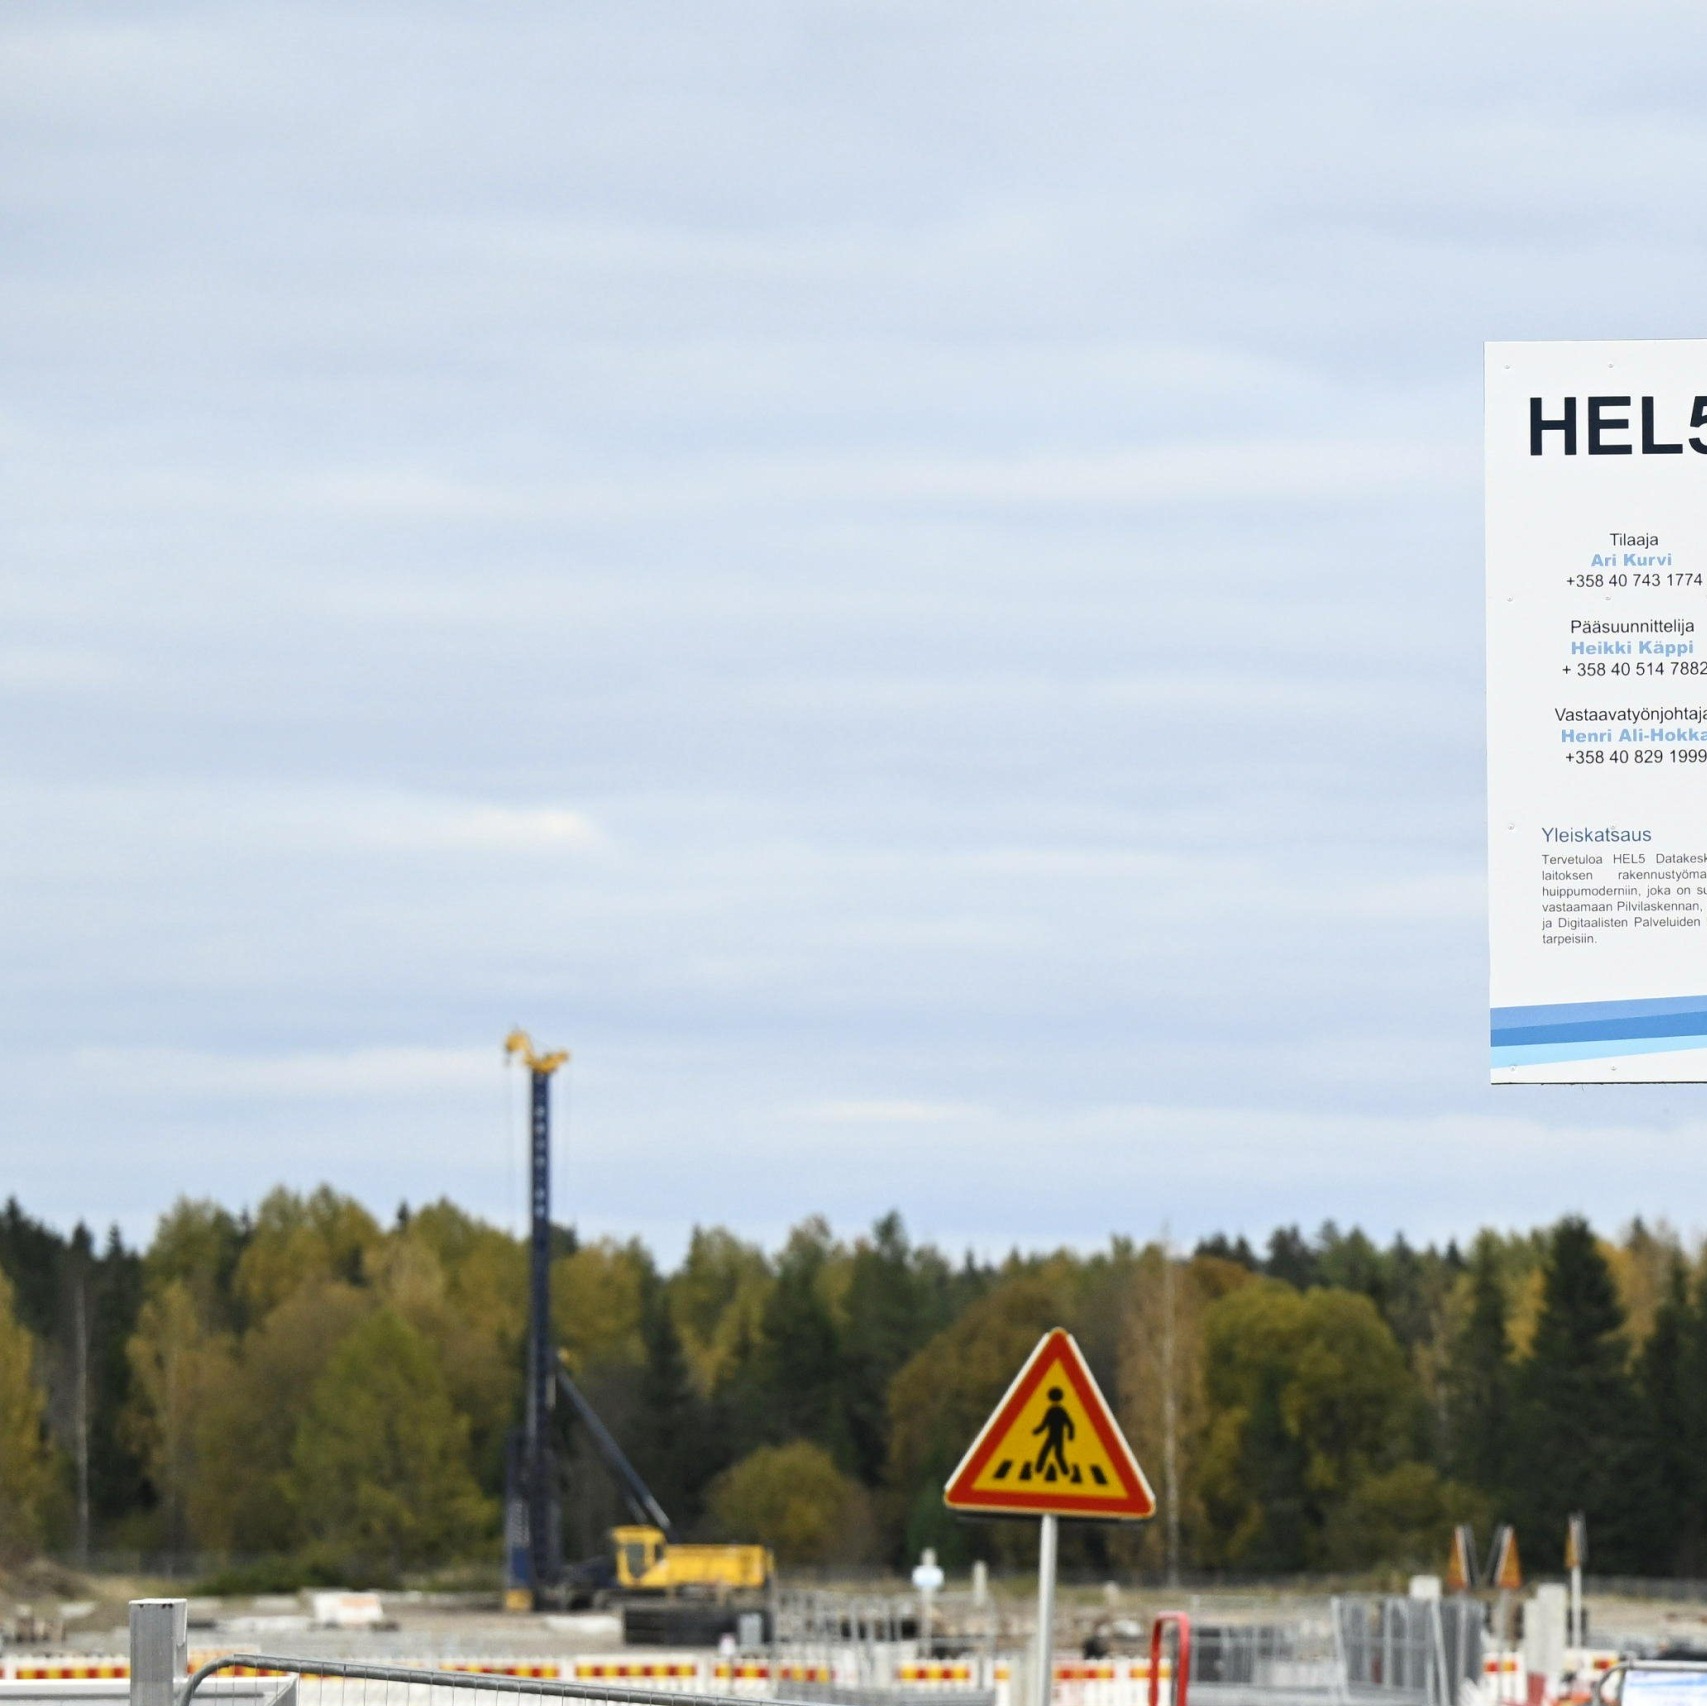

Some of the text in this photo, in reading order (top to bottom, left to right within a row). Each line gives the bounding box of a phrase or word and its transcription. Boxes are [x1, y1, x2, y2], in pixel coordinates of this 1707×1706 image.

[1610, 533, 1658, 549] Tilaaja
[1591, 553, 1671, 566] Ari Kurvi
[1567, 573, 1702, 587] +358 40 743 1774
[1571, 619, 1694, 636] Pääsuunnittelija
[1572, 640, 1693, 657] Heikki Käppi
[1578, 663, 1605, 676] 358
[1611, 662, 1630, 676] 40
[1636, 662, 1664, 676] 514
[1671, 661, 1707, 675] 7882
[1562, 729, 1611, 743] Henri
[1566, 749, 1707, 764] +358 40 829 1999
[1542, 828, 1651, 842] Yleiskatsaus
[1542, 854, 1602, 864] Tervetuloa
[1614, 854, 1645, 864] HEL5
[1542, 870, 1592, 880] laitoksen
[1543, 885, 1640, 898] huippumoderniin,
[1647, 886, 1670, 898] joka
[1677, 887, 1690, 895] on
[1542, 903, 1612, 912] vastaamaan
[1617, 901, 1702, 912] Pilvilaskennan,
[1542, 918, 1552, 930] ja
[1559, 918, 1628, 930] Digitaalisten
[1635, 917, 1700, 927] Palveluiden
[1543, 934, 1597, 946] tarpeisiin.
